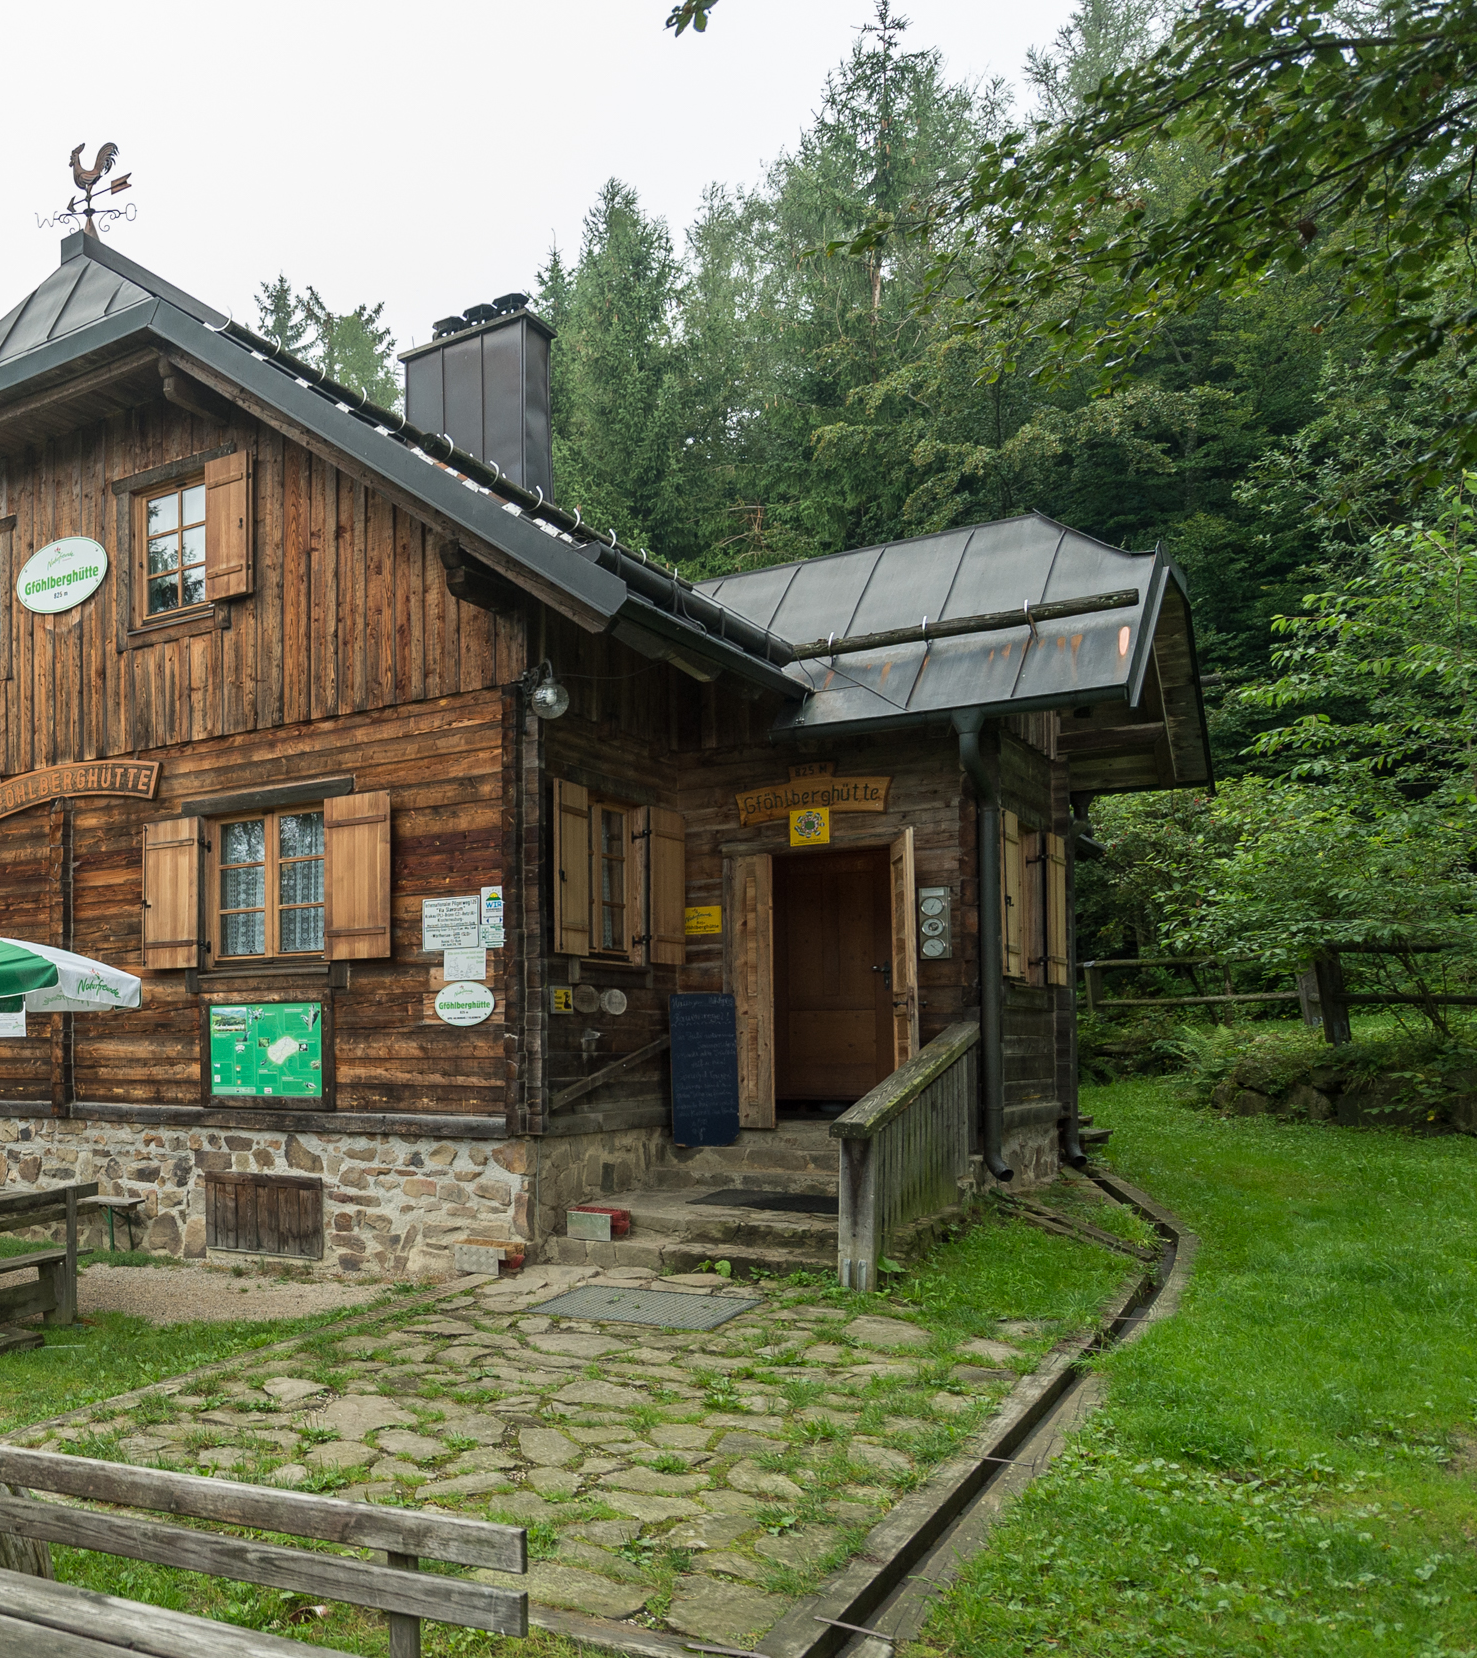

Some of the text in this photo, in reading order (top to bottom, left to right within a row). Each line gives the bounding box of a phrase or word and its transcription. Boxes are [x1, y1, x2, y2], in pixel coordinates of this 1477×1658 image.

[24, 565, 99, 596] Gföhlberghütte
[53, 591, 63, 600] 825
[794, 764, 827, 777] 825 M
[743, 783, 880, 815] Gföhlberghütte
[486, 900, 502, 908] WIR
[77, 978, 121, 999] Naturfreunde
[438, 1000, 491, 1010] Gföhlberghütte
